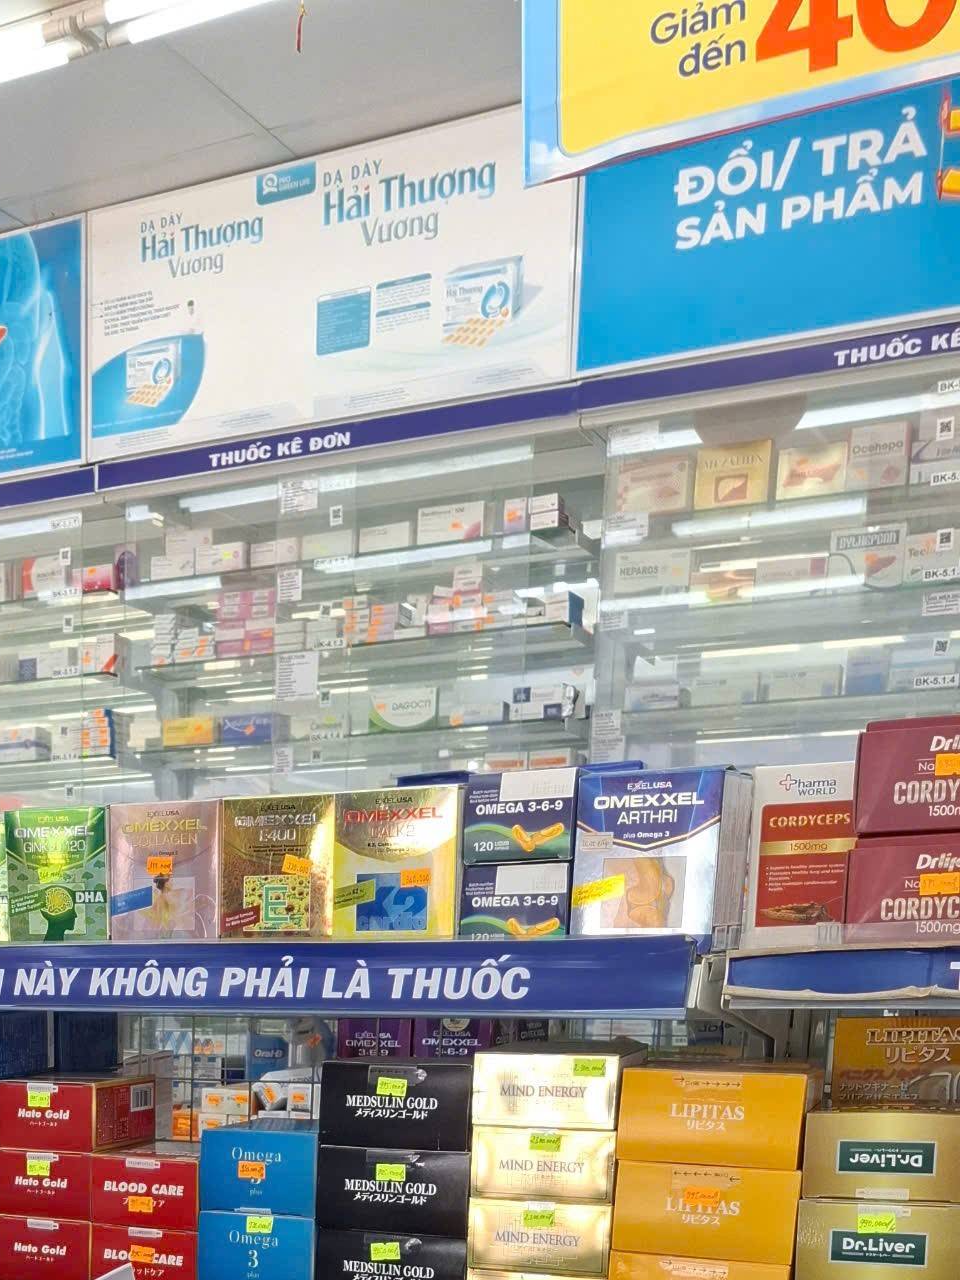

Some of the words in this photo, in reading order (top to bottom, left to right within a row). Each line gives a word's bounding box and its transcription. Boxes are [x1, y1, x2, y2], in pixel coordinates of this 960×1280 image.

[650, 0, 746, 46] Giảm
[678, 33, 746, 77] đến
[675, 140, 802, 206] ĐỔI/
[812, 106, 927, 177] TRẢ
[323, 184, 372, 226] Hải
[380, 161, 497, 210] Thượng
[675, 197, 767, 250] SẢN
[781, 168, 924, 231] PHẨM
[360, 210, 439, 248] Vương
[140, 231, 176, 263] Hải
[182, 216, 264, 254] Thượng
[168, 251, 224, 279] Vương
[834, 334, 922, 366] THUỐC
[209, 440, 271, 468] THUỐC
[276, 437, 304, 458] KÊ
[309, 431, 351, 451] ĐƠN
[798, 786, 837, 796] WORLD
[475, 803, 524, 816] OMEGA
[528, 800, 563, 812] 3-6-9
[593, 791, 705, 810] OMEXXEL
[617, 810, 678, 825] ARTHRI
[769, 812, 851, 828] CORDYCEPS
[636, 830, 663, 839] Omega
[790, 841, 828, 852] 1500mg
[76, 892, 103, 903] DHA
[13, 960, 80, 997] NÀY
[88, 959, 209, 997] KHÔNG
[219, 955, 308, 998] PHẢI
[322, 959, 371, 999] LÀ
[388, 954, 531, 1000] THUỐC
[886, 1046, 951, 1062] リピタス
[500, 1084, 535, 1098] MIND
[538, 1085, 587, 1098] ENERGY
[346, 1095, 404, 1109] MEDSULIN
[406, 1097, 438, 1110] GOLD
[18, 1108, 42, 1120] Hato
[45, 1109, 70, 1120] Gold
[354, 1109, 429, 1120] メディスリンゴールド
[669, 1103, 745, 1120] LIPITAS
[231, 1147, 282, 1164] Omega
[850, 1154, 923, 1168] Dr.Liver
[499, 1158, 534, 1172] MIND
[536, 1160, 584, 1174] ENERGY
[103, 1181, 147, 1194] BLOOD
[151, 1183, 184, 1196] CARE
[344, 1179, 403, 1195] MEDSULIN
[405, 1182, 437, 1196] GOLD
[842, 1237, 915, 1253] Dr.Liver
[154, 1253, 184, 1266] CARE
[247, 1249, 259, 1268] 3
